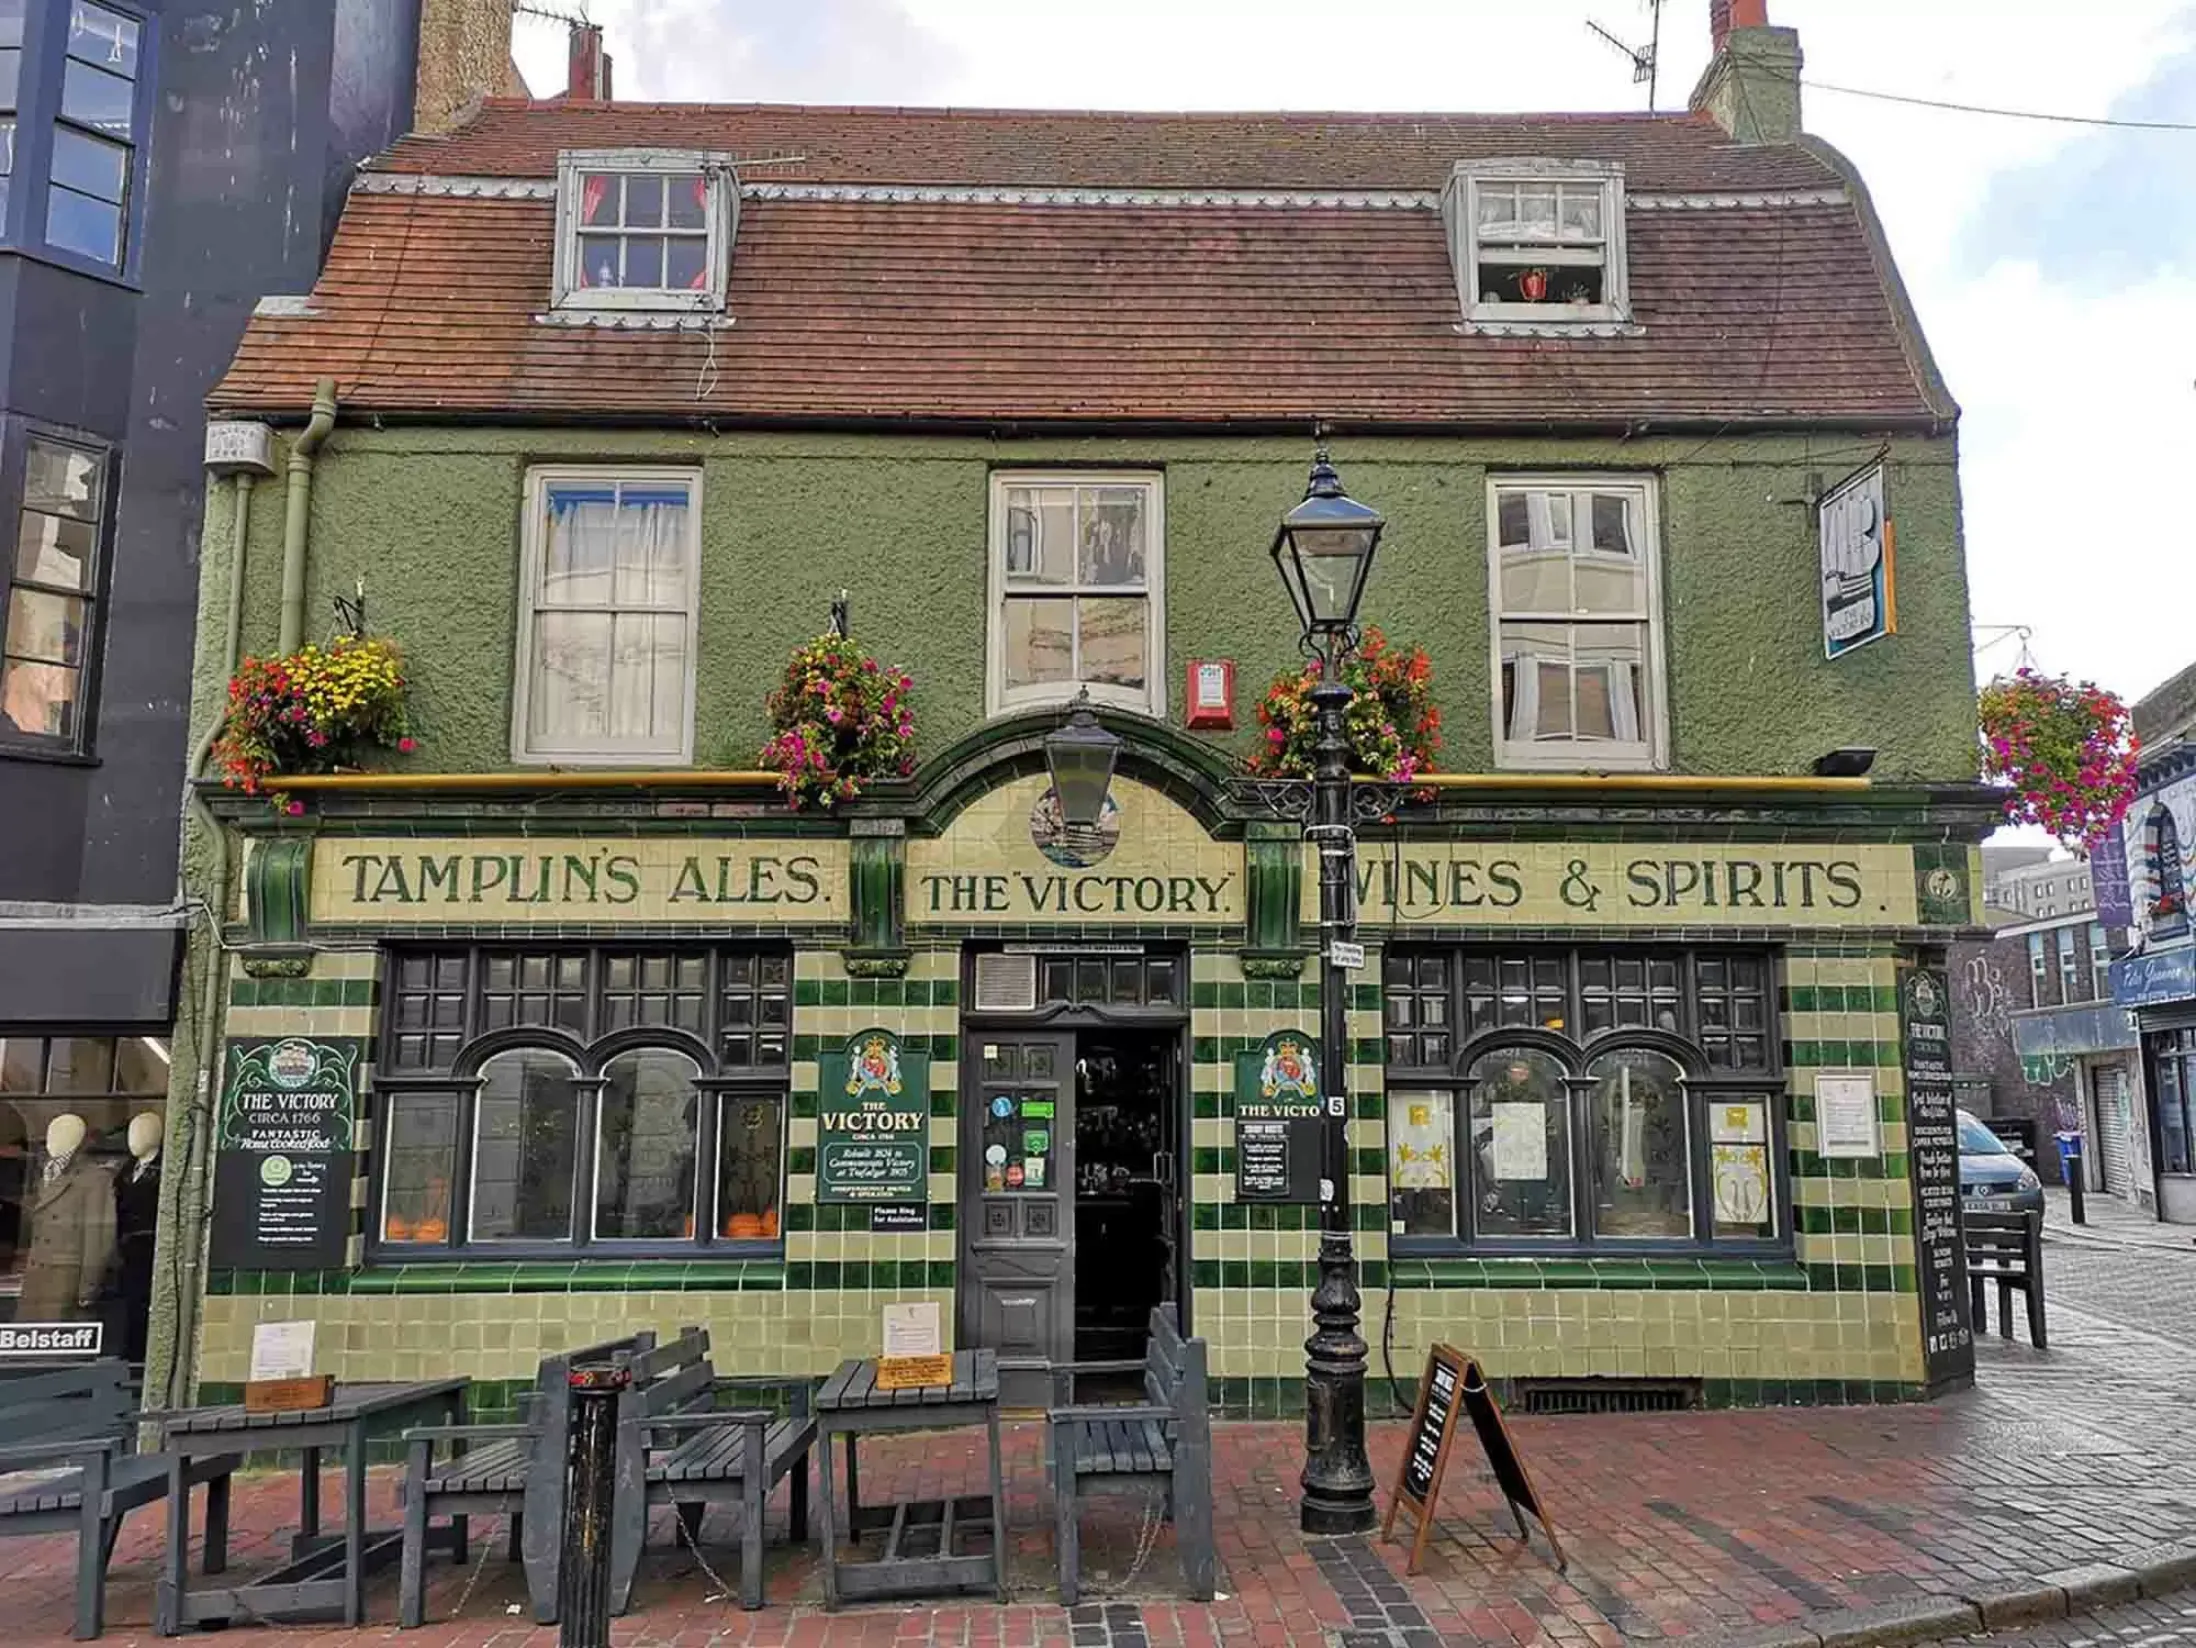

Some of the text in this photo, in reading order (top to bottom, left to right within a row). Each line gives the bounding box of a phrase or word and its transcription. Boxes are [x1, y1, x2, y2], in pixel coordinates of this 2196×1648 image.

[342, 847, 832, 904] TAMPLIN'S ALES.
[920, 876, 1010, 912] THE
[1559, 859, 1602, 912] &
[242, 1093, 338, 1110] THE VICTORY
[862, 1101, 887, 1111] THE
[1333, 1100, 1342, 1114] 5
[249, 1112, 321, 1124] CIRCA 1766
[1239, 1104, 1270, 1117] THE
[822, 1112, 923, 1130] VICTORY
[252, 1129, 321, 1139] FANTASTIC
[0, 1329, 94, 1348] Belstaff
